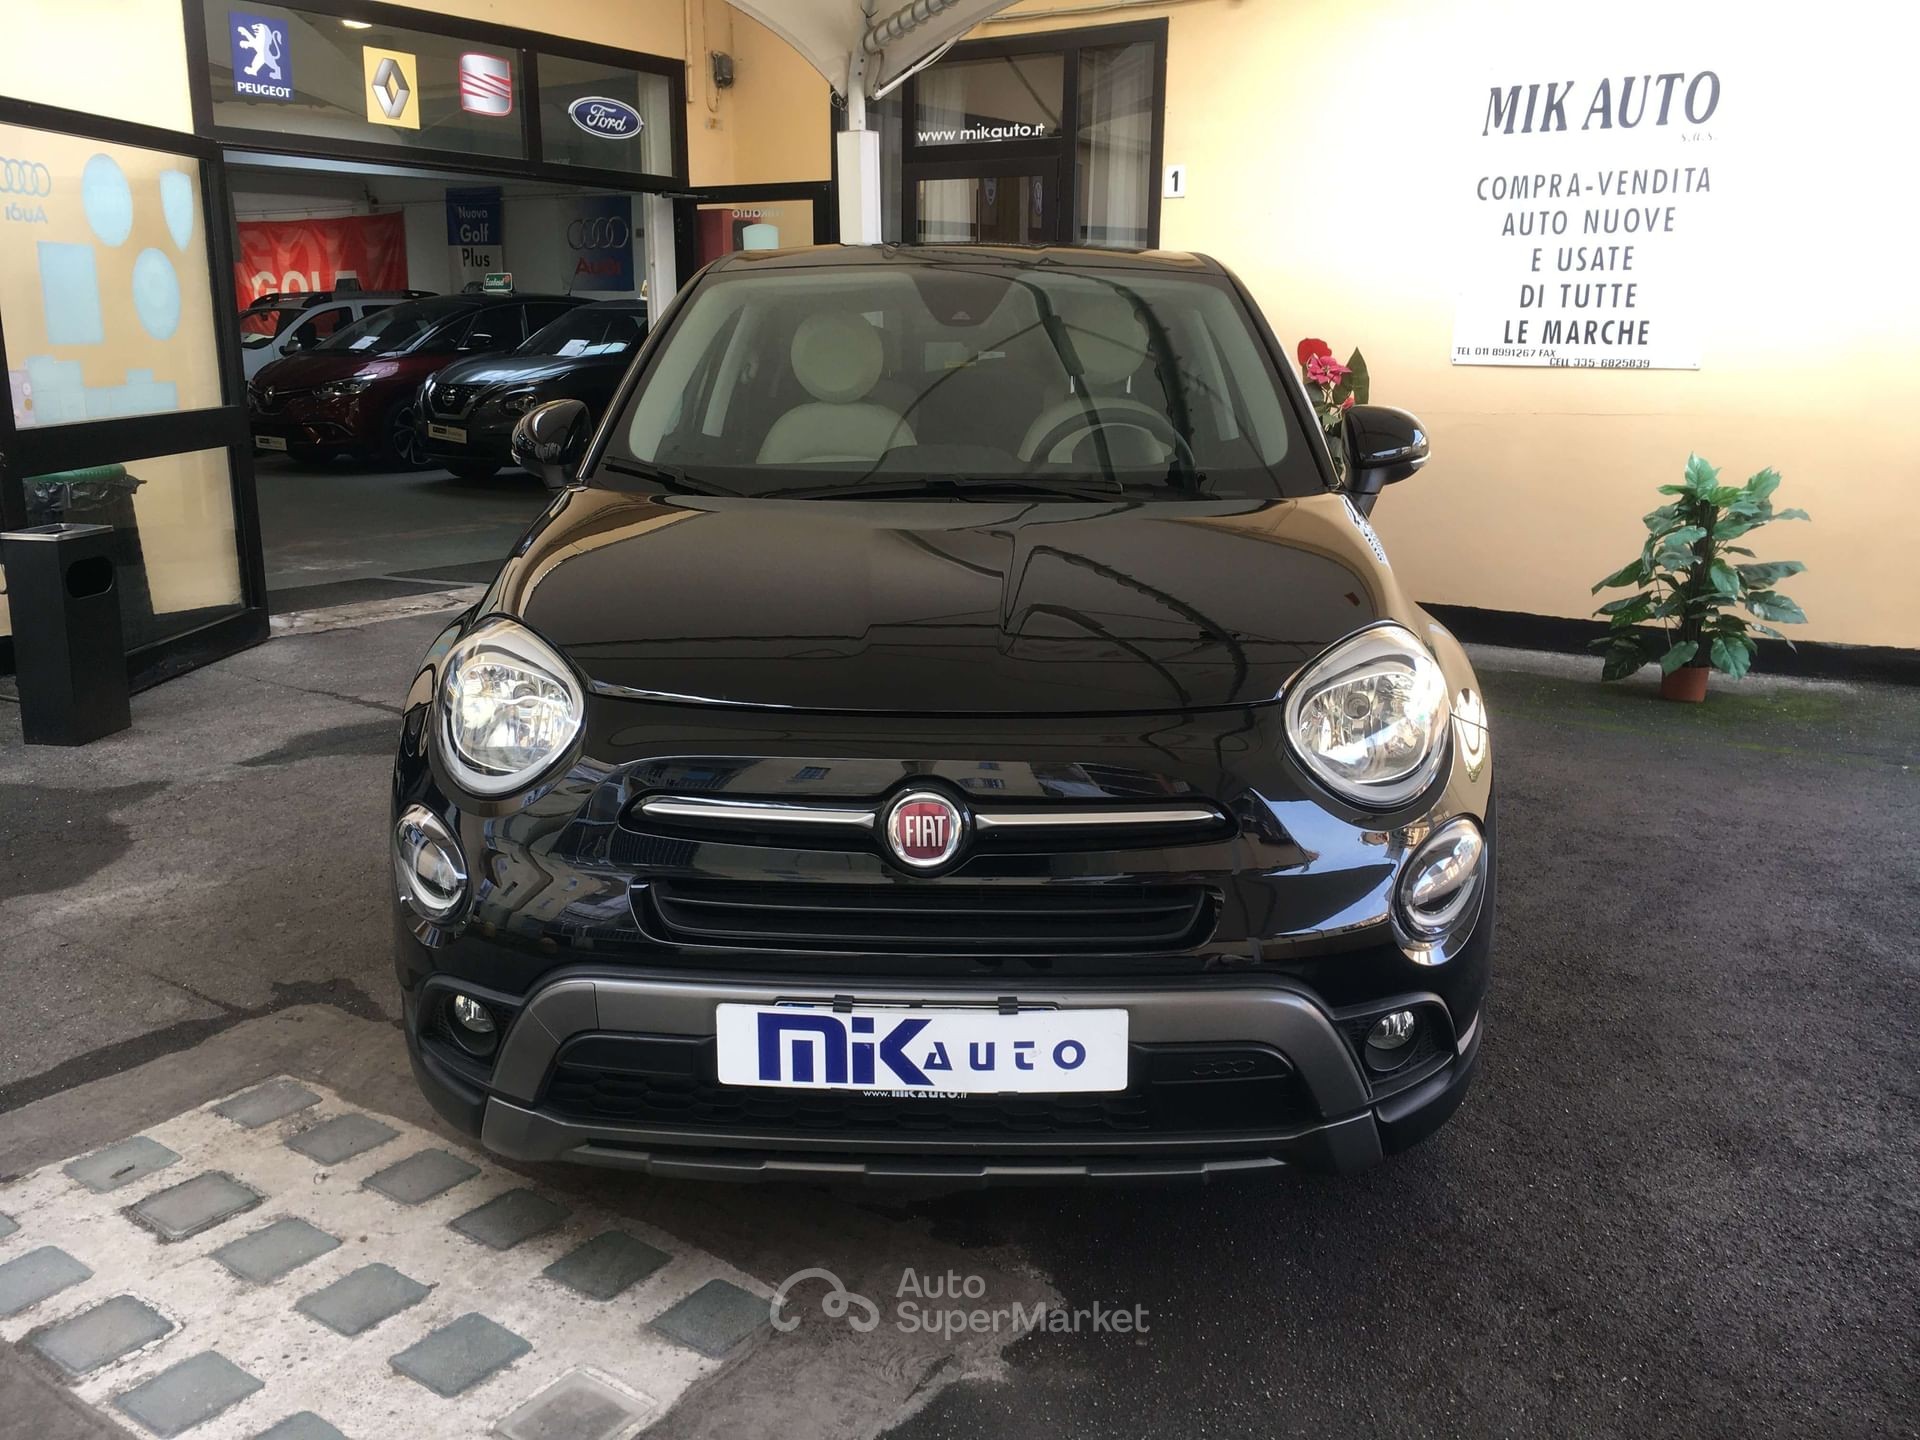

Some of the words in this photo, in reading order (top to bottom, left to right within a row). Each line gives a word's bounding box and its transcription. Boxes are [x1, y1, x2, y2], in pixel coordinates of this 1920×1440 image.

[237, 81, 292, 98] PEUGEOT
[1482, 80, 1574, 136] MIK
[1581, 70, 1721, 131] AUTO
[586, 104, 627, 132] Ford
[1171, 170, 1179, 192] 1
[1477, 167, 1711, 201] COMPRA-VENDITA
[458, 206, 488, 218] Nuova
[1502, 210, 1568, 236] AUTO
[1583, 206, 1676, 234] NUOVE
[460, 223, 489, 243] Golf
[462, 248, 490, 267] Plus
[1531, 248, 1542, 272] E
[1557, 246, 1634, 271] USATE
[1520, 284, 1544, 308] DI
[1560, 283, 1637, 308] TUTTE
[1504, 320, 1529, 344] LE
[1542, 320, 1650, 345] MARCHE
[1457, 347, 1470, 355] TEL
[1539, 349, 1556, 357] FAX
[905, 815, 947, 847] FIAT
